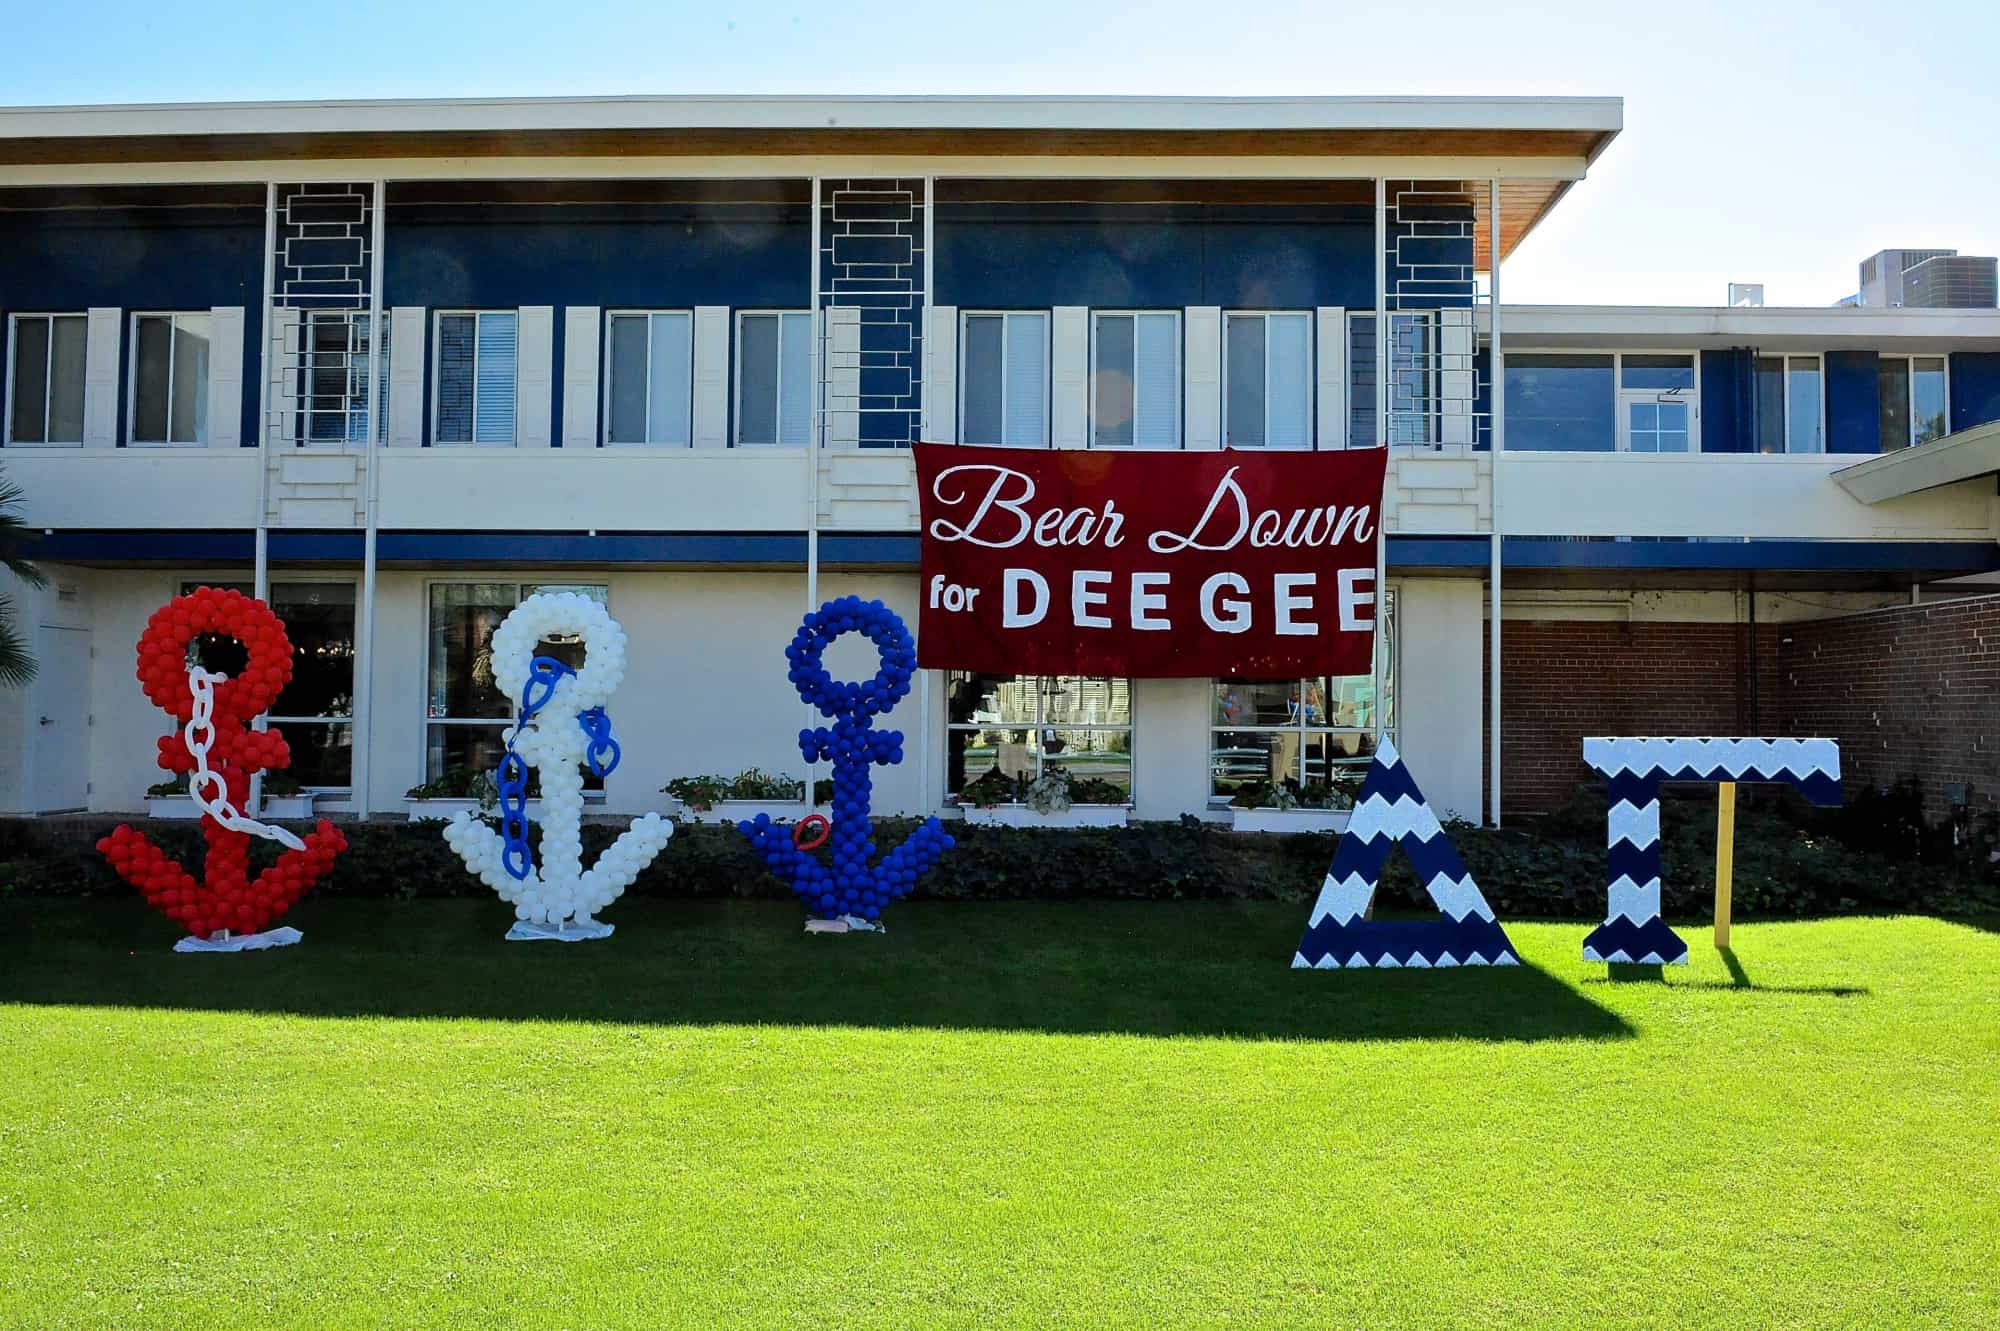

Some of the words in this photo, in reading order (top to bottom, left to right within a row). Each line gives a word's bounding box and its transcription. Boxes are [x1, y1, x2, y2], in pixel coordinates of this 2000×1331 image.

[930, 464, 1125, 549] Bear
[1148, 465, 1375, 553] Down
[930, 574, 980, 613] for
